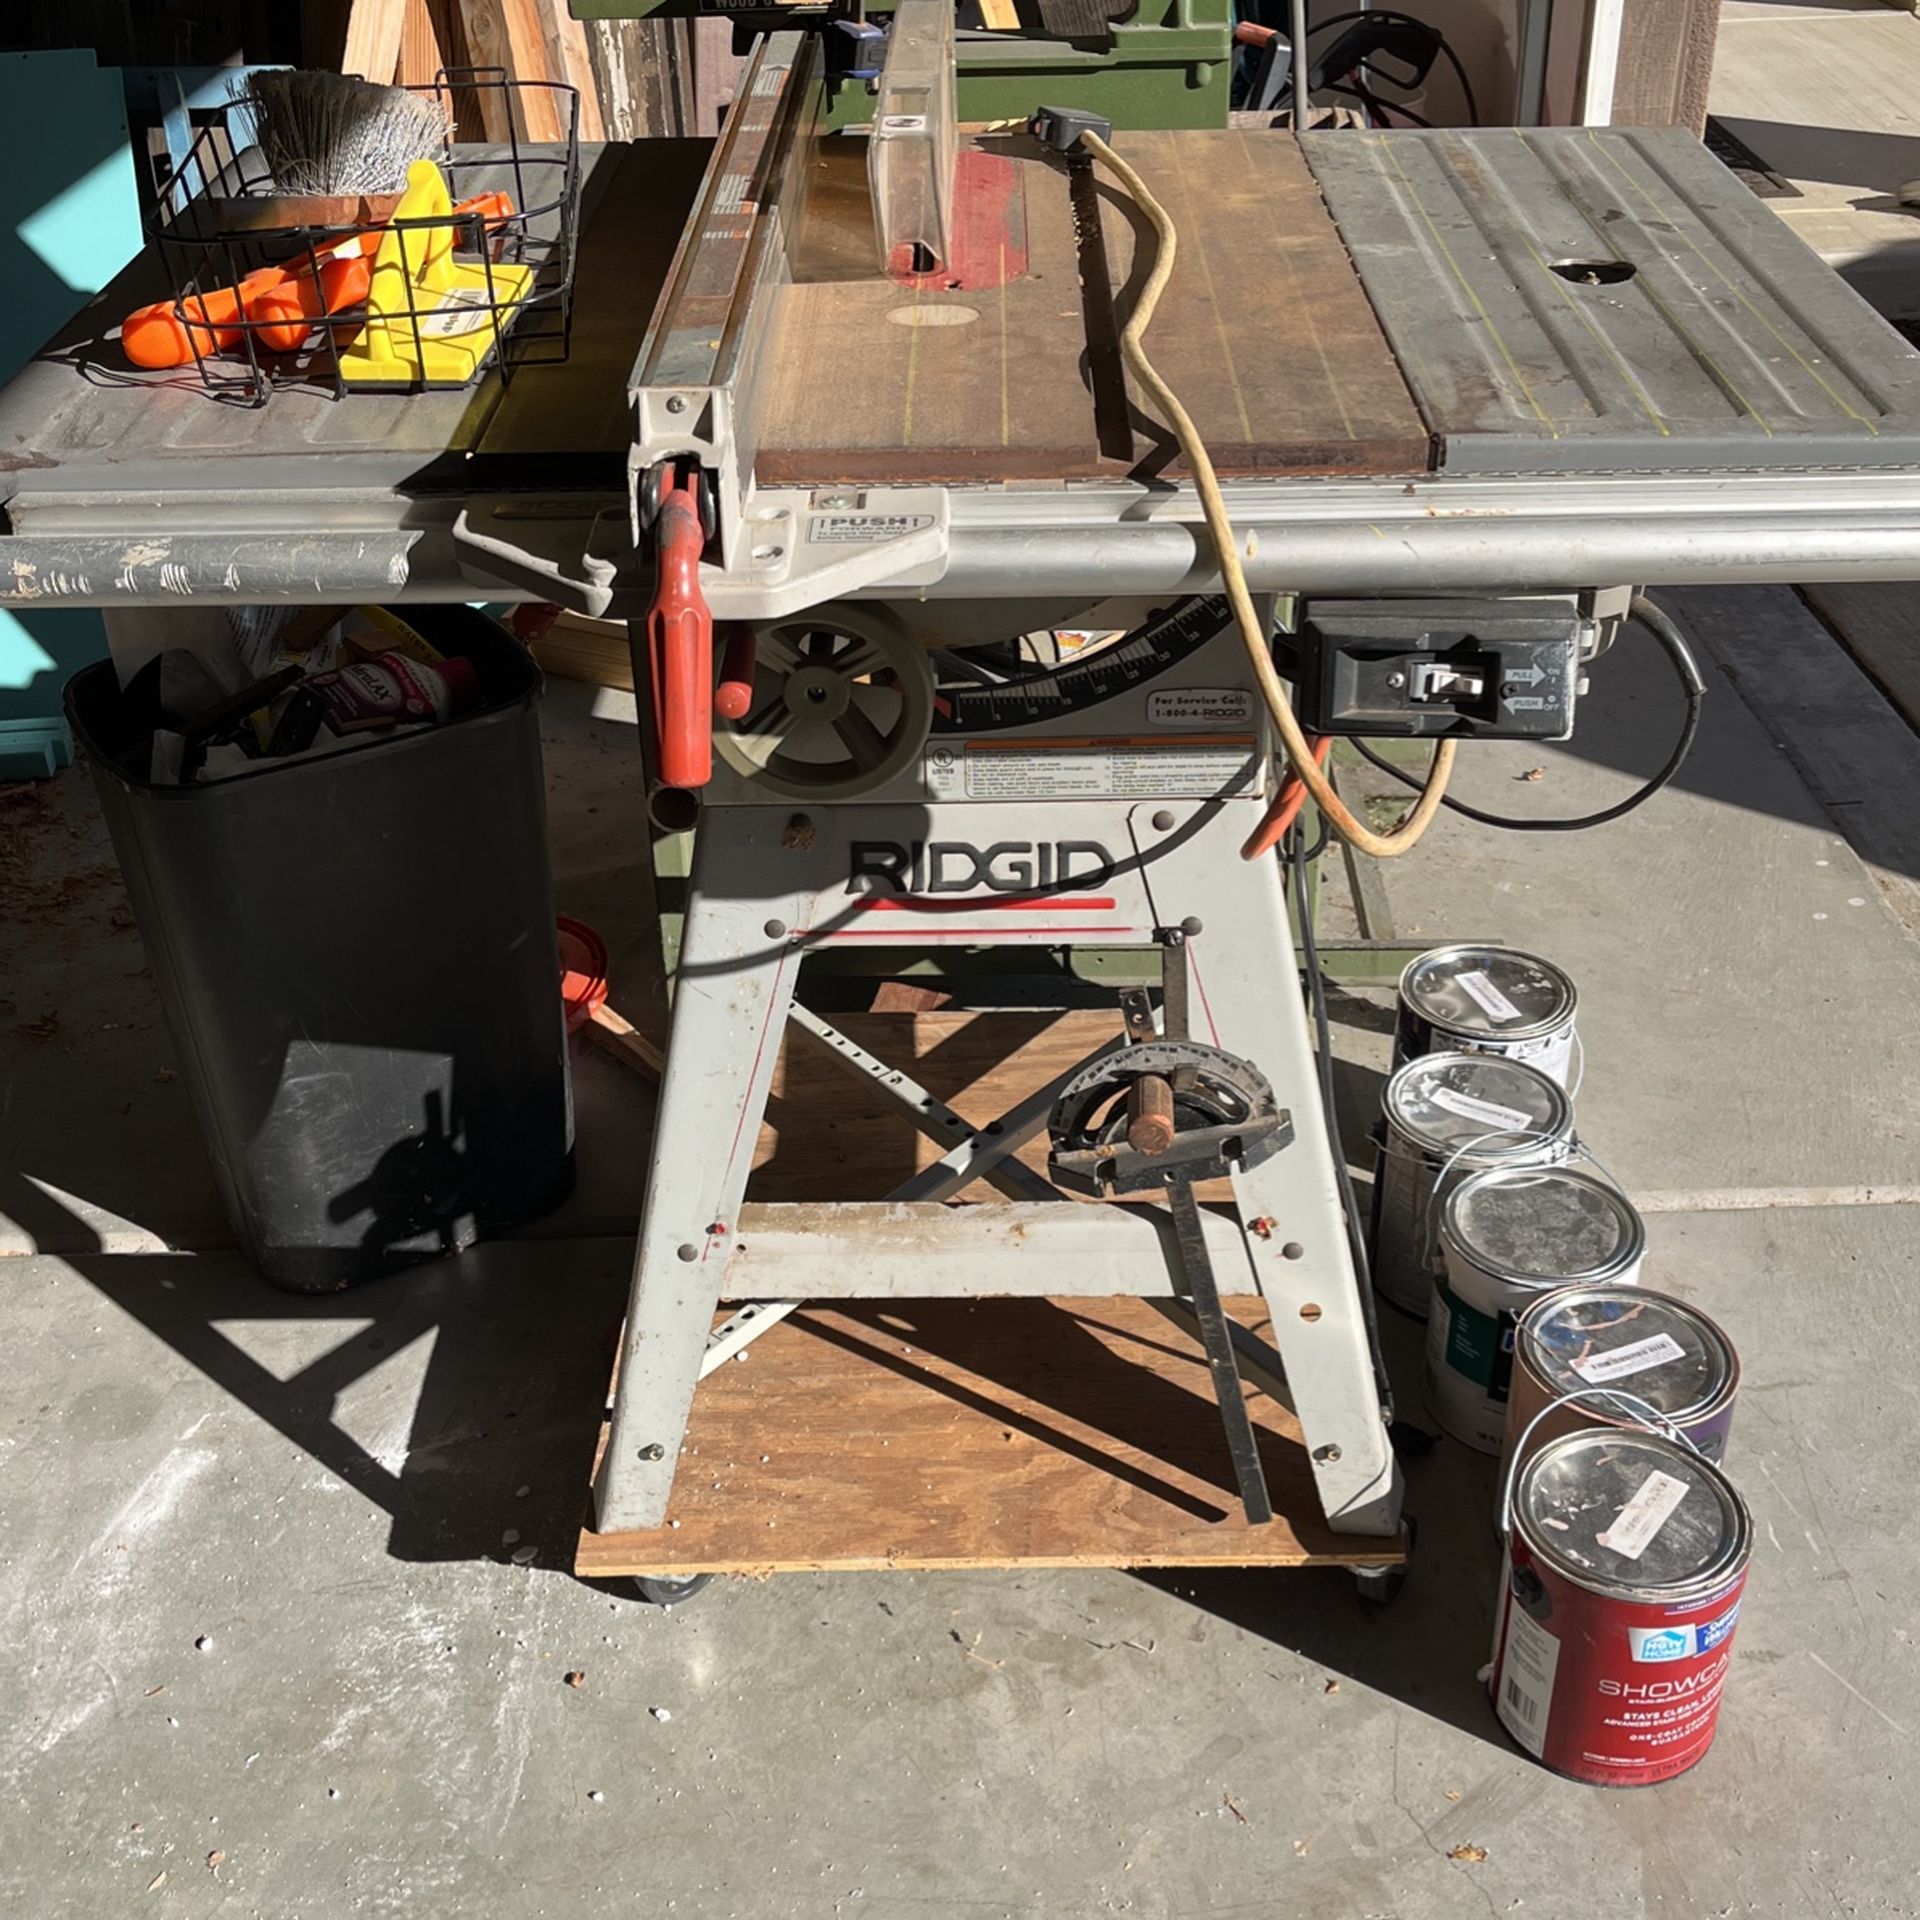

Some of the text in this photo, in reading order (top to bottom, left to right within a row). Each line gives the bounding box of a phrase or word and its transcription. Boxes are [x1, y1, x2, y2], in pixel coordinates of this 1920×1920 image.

[830, 517, 907, 527] PUSH
[1511, 671, 1534, 679] PULL
[1155, 697, 1173, 705] For
[1176, 697, 1218, 705] Service
[1514, 698, 1539, 706] PUSH
[845, 840, 1116, 893] RIDGID
[1645, 1639, 1683, 1651] HGTV
[1644, 1648, 1683, 1659] HOME
[1598, 1652, 1730, 1697] SHOWCA
[1623, 1712, 1660, 1721] STAYS
[1603, 1717, 1652, 1728] ADVANCED
